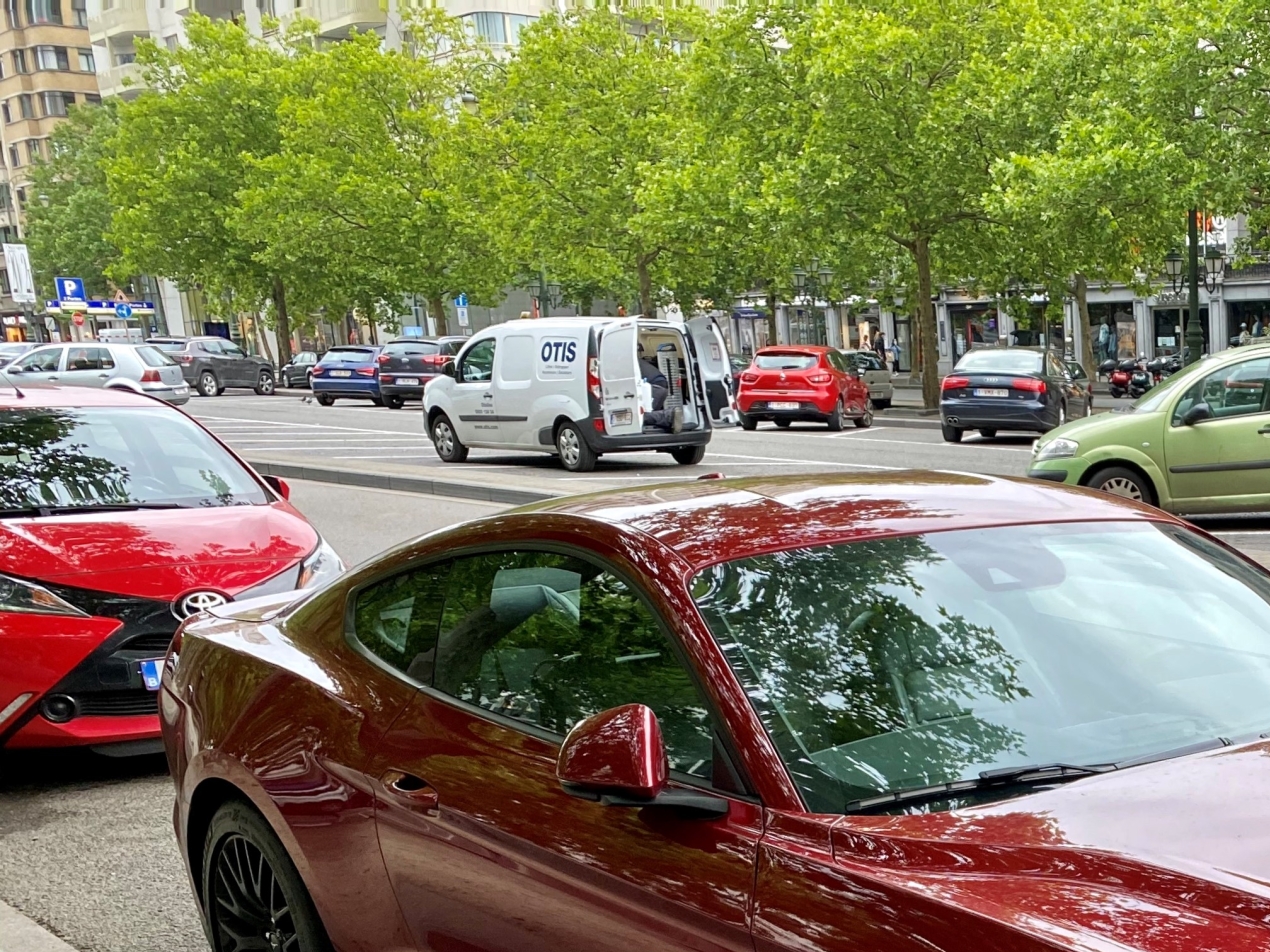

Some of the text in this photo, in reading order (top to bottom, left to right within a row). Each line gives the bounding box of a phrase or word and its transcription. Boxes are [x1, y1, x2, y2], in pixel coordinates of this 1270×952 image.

[63, 280, 76, 296] P
[541, 341, 576, 362] OTIS
[148, 677, 158, 687] B
